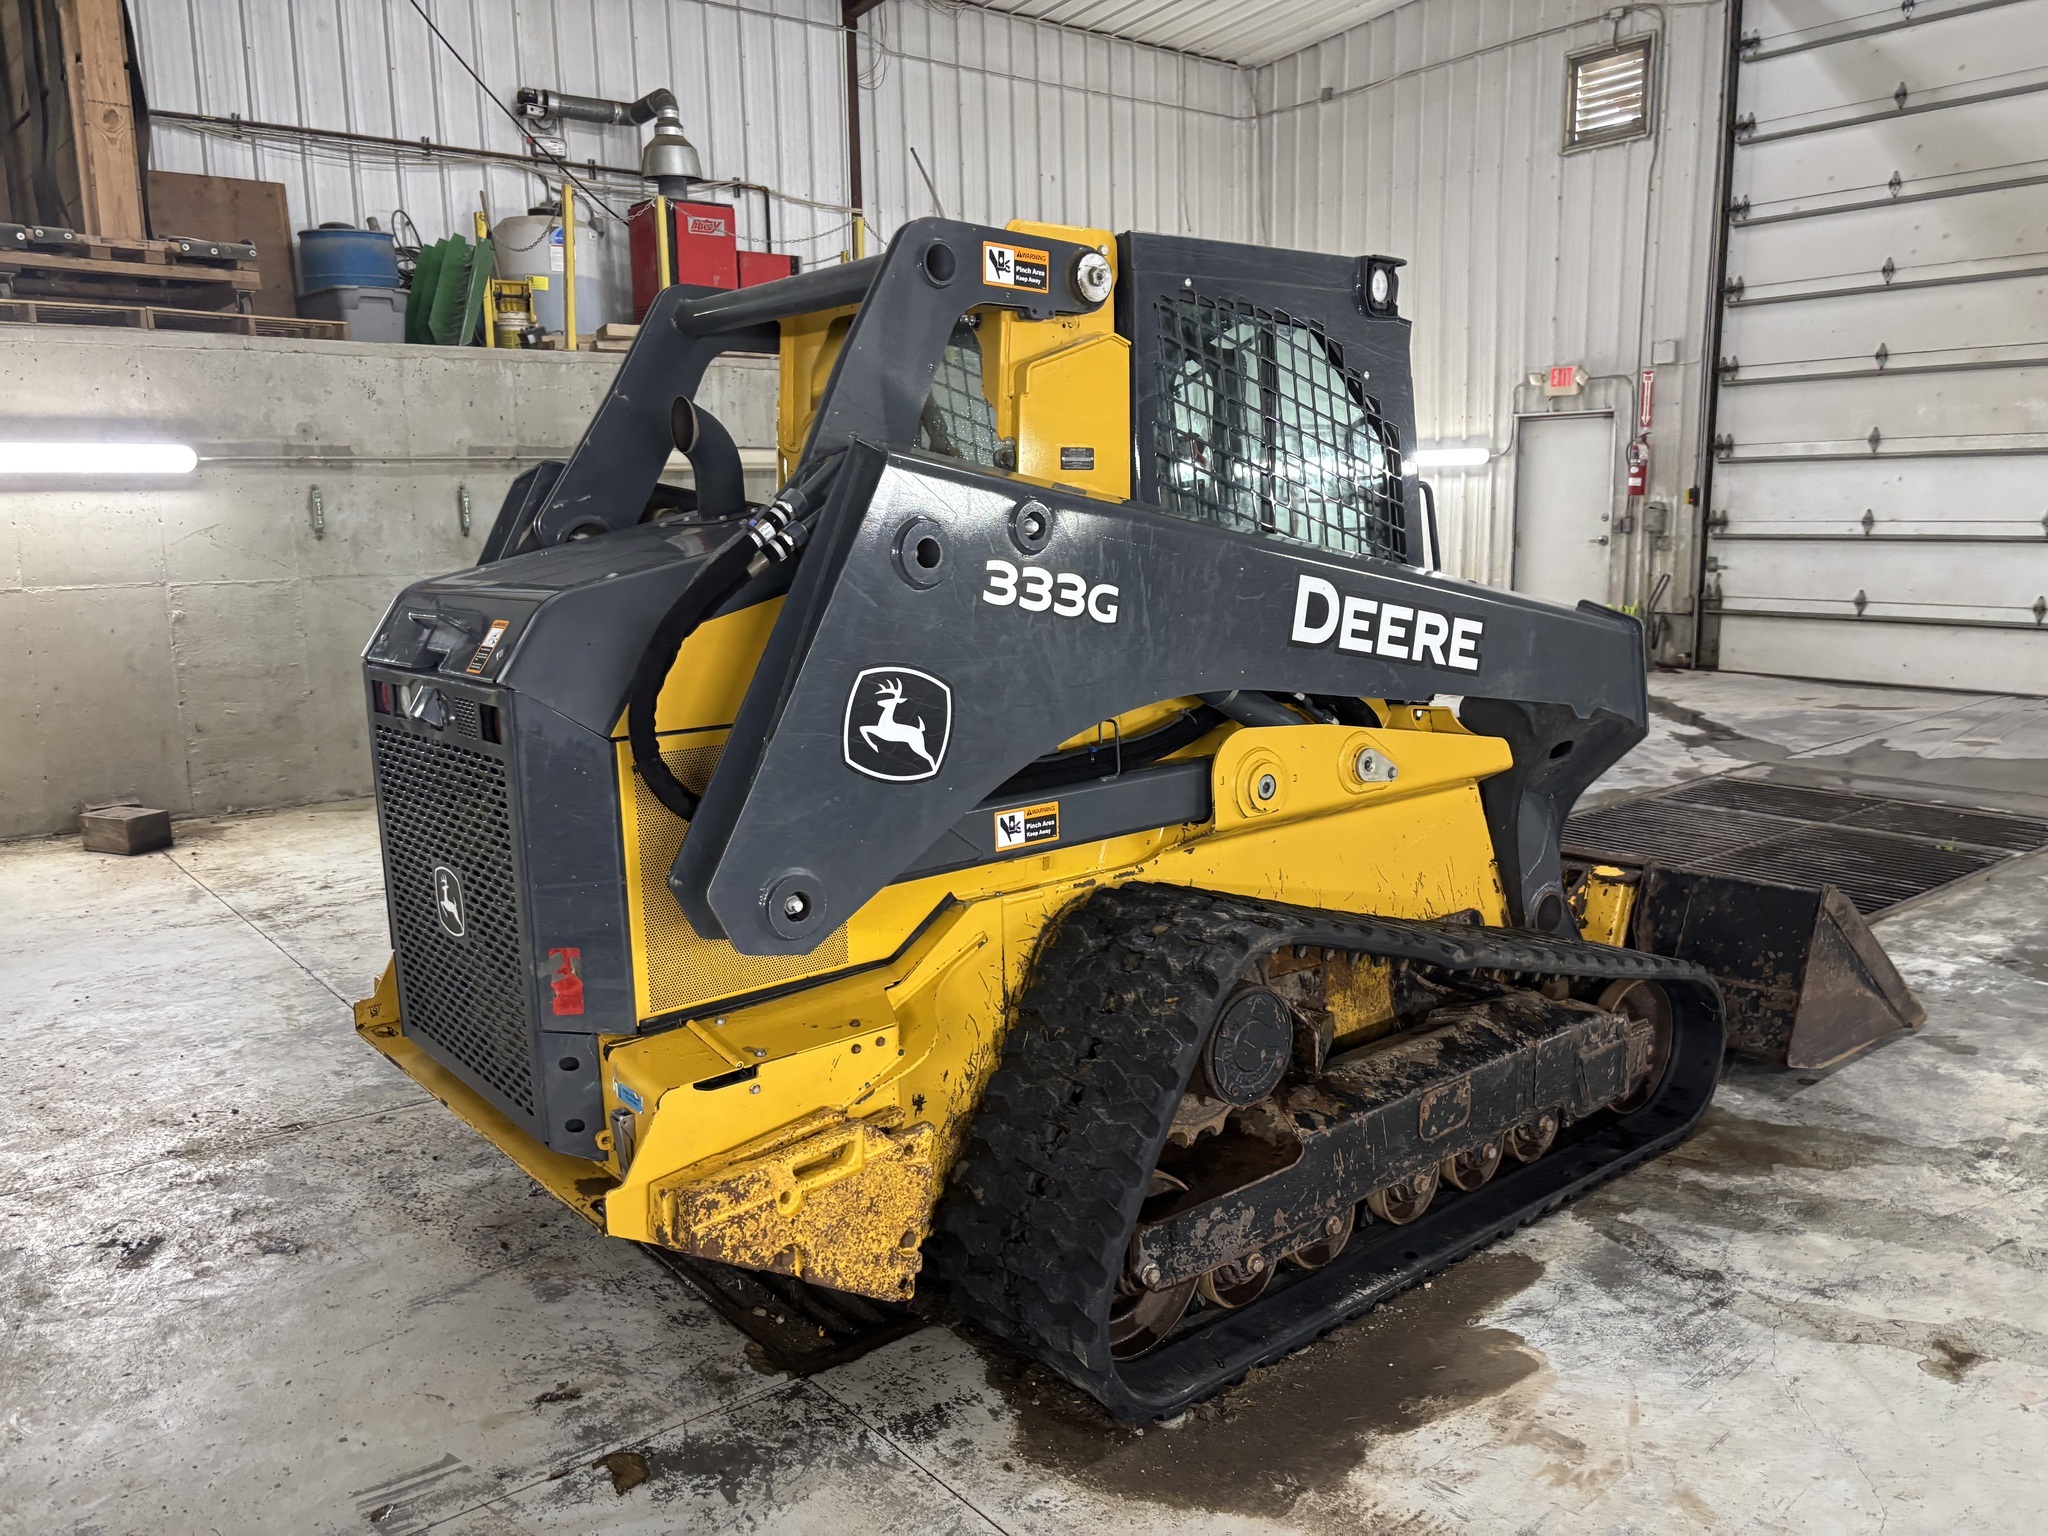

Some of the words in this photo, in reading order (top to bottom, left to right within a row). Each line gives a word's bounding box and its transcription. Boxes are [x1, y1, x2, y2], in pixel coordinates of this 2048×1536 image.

[1021, 252, 1046, 261] WARNING
[1015, 265, 1031, 274] Pinch
[1032, 268, 1045, 277] Area
[1015, 275, 1028, 283] Keep
[1028, 277, 1041, 285] Away
[1551, 367, 1573, 387] EXIT
[982, 559, 1119, 624] 333G
[1291, 574, 1483, 671] DEERE
[1031, 806, 1055, 815] WARNING
[1026, 821, 1041, 830] Pinch
